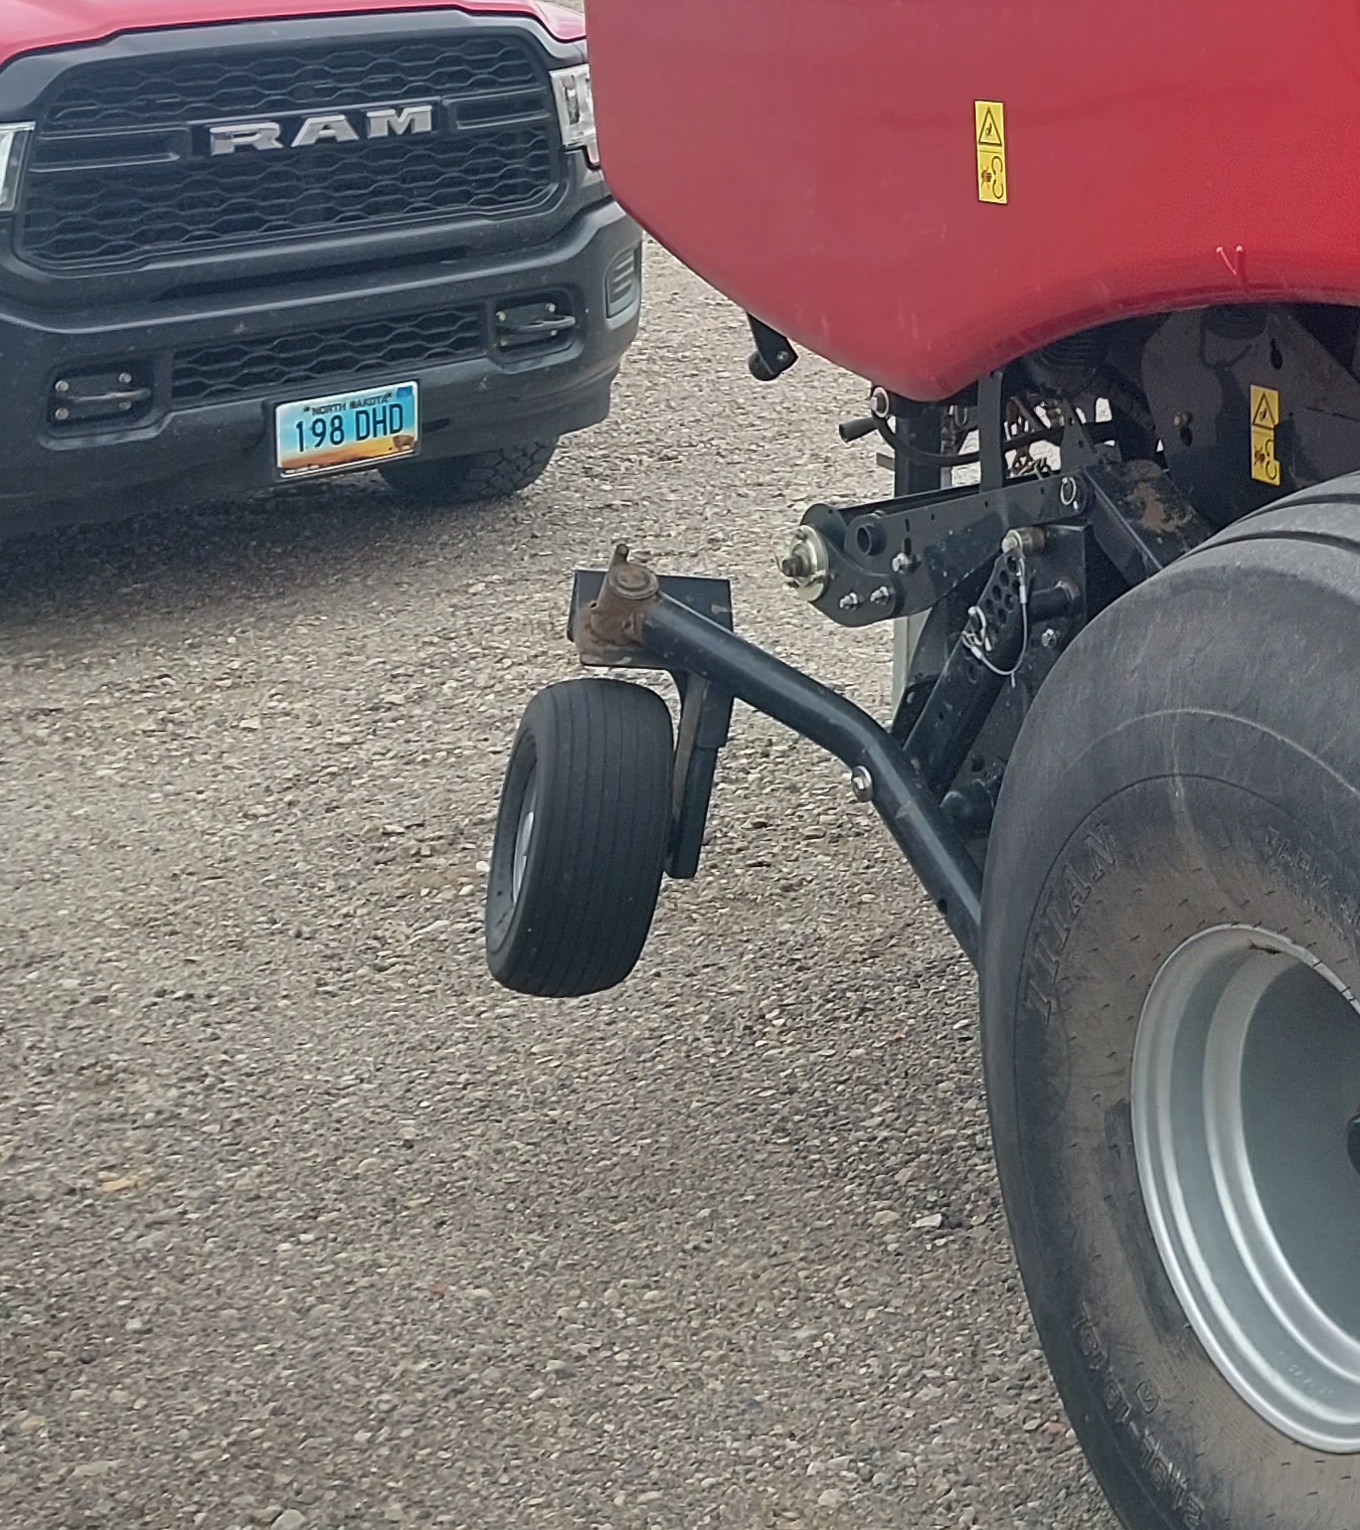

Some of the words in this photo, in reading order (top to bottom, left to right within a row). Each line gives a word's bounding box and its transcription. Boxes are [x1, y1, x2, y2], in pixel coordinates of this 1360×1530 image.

[209, 104, 433, 157] RAM
[296, 414, 346, 453] 198
[354, 402, 404, 442] DHD
[311, 402, 347, 416] NORTH
[1022, 818, 1117, 1028] TITAN
